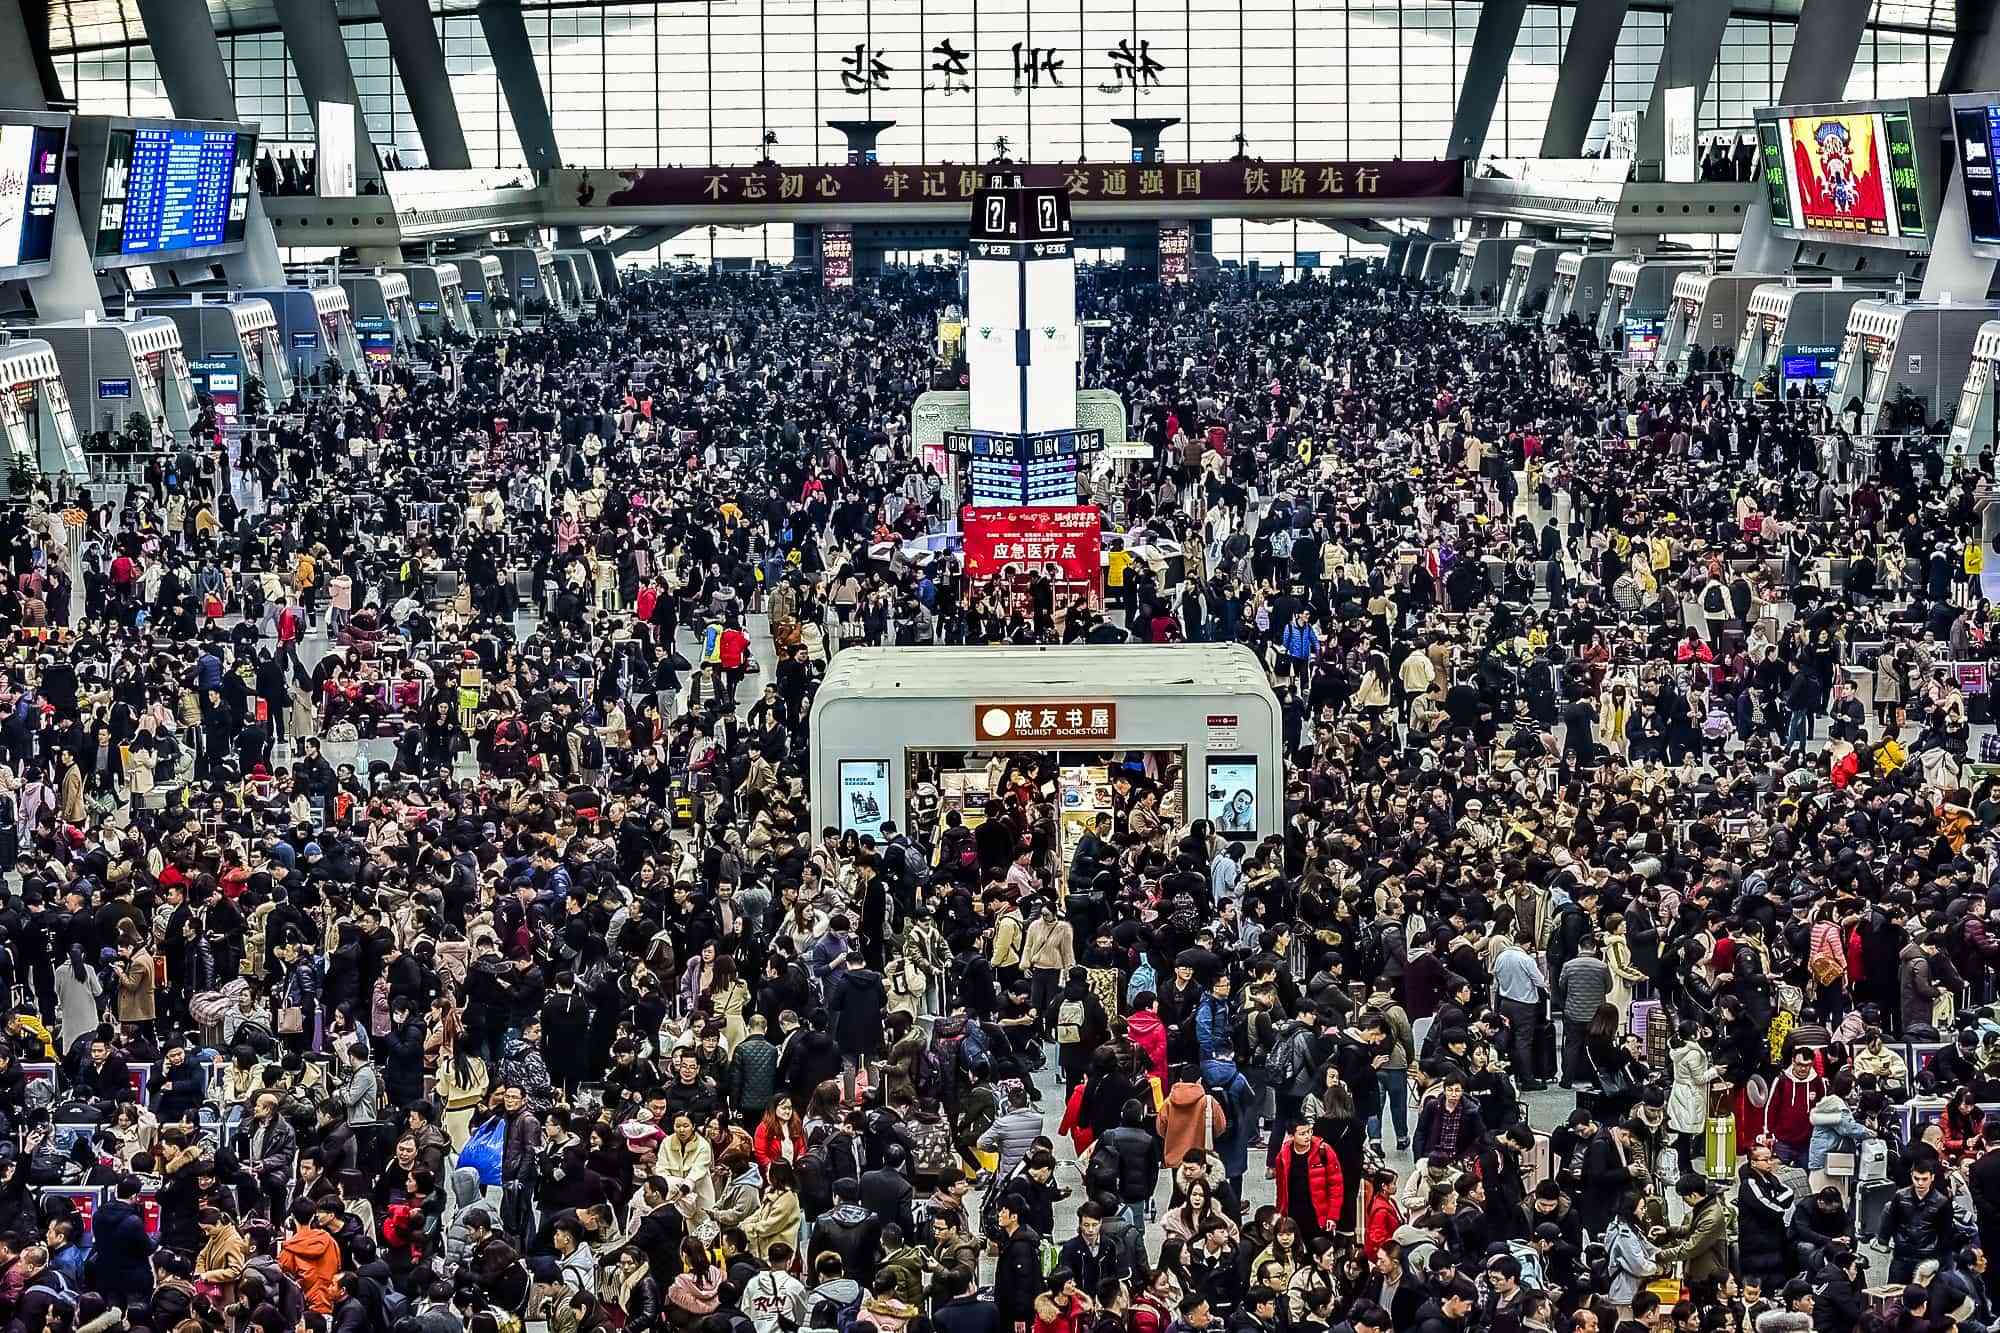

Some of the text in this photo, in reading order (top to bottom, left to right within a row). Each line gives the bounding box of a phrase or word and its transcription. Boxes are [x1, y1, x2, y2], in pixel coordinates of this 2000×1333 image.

[703, 167, 1382, 199] 不忘初心 牢记使 交通强国 铁路先行
[1797, 346, 1836, 354] Hisense
[188, 361, 227, 369] Hisense
[993, 543, 1076, 559] 应急医疗点
[1014, 708, 1109, 729] 旅友书屋
[1015, 727, 1109, 736] TOURIST BOOKSTORE
[751, 1295, 787, 1312] RUN
